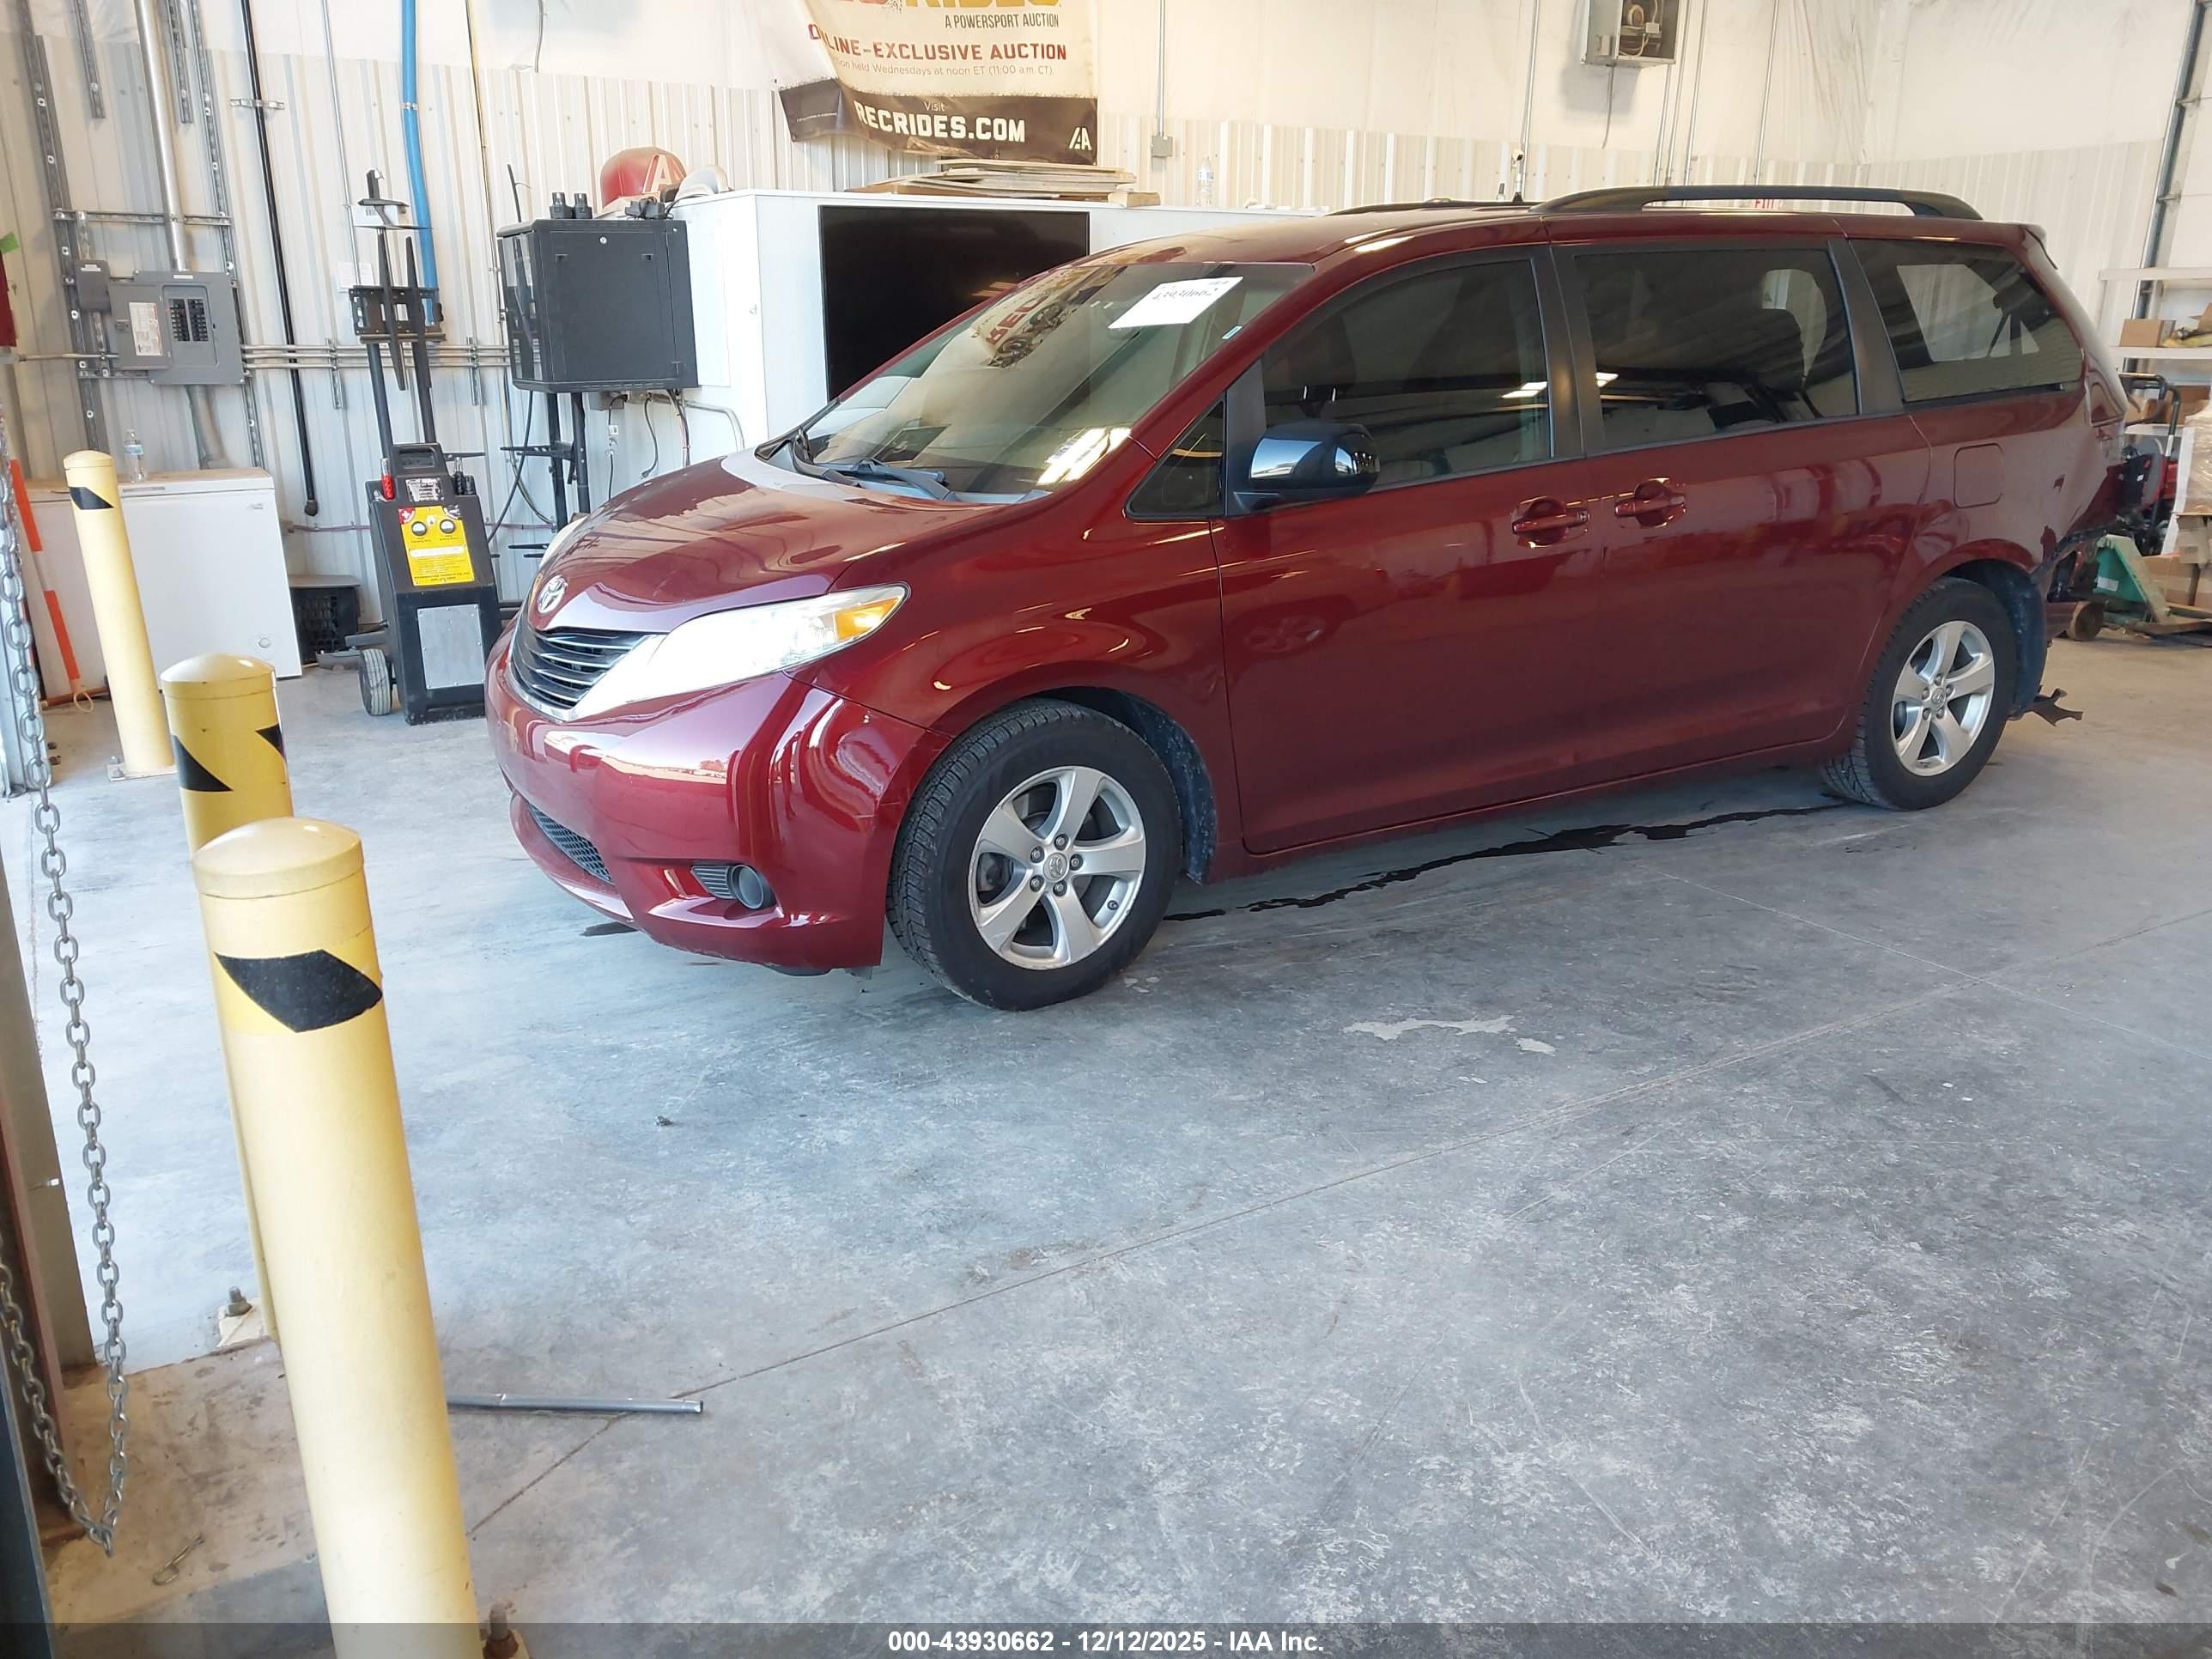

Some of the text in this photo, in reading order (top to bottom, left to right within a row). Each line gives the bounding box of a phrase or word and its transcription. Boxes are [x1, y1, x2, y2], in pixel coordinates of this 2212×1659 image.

[945, 13, 1059, 28] A POWERSPORT AUCTION
[990, 43, 1066, 60] AUCTION
[872, 63, 932, 76] Wednesdays
[934, 66, 944, 76] at
[946, 67, 970, 76] noon
[974, 66, 985, 76] ET
[923, 100, 945, 112] Visit
[854, 100, 1025, 143] RECRIDES.COM
